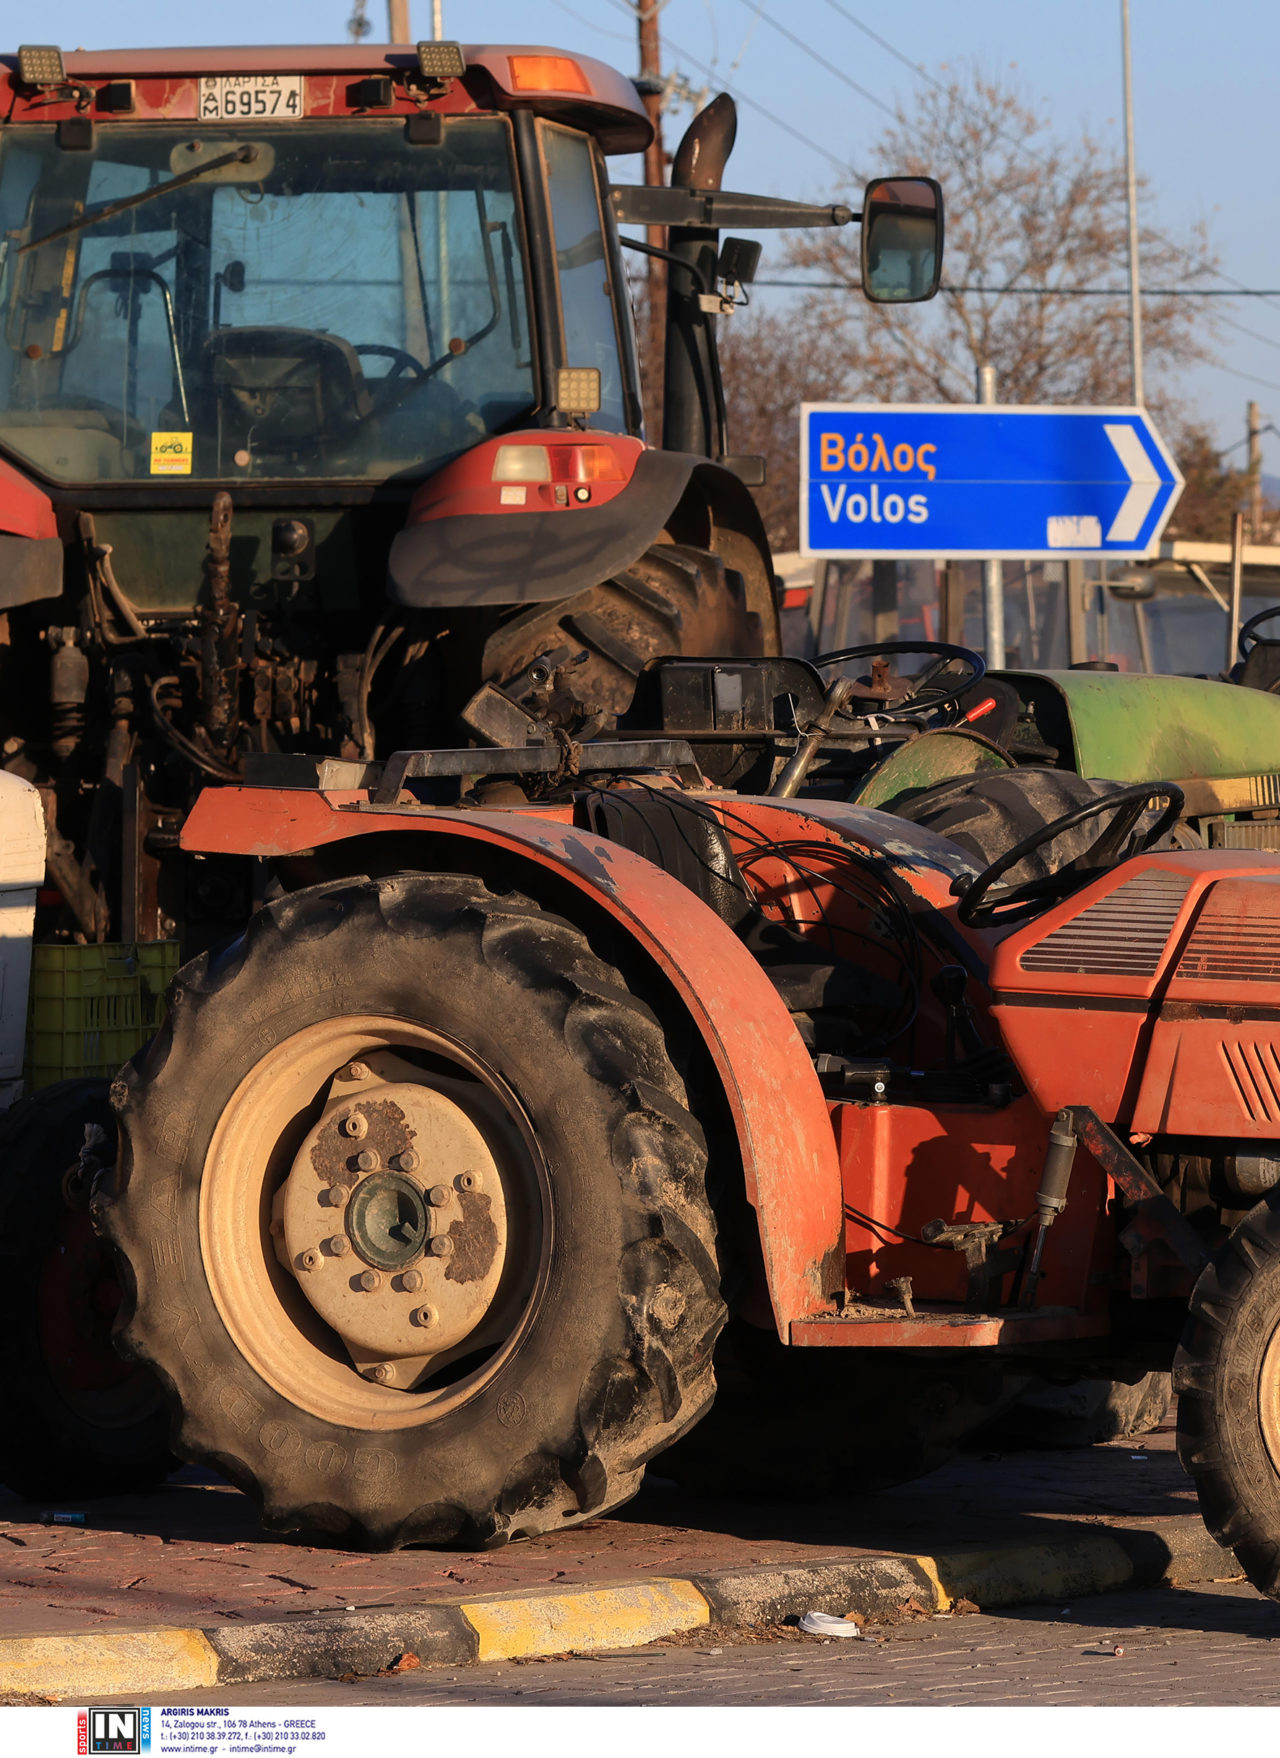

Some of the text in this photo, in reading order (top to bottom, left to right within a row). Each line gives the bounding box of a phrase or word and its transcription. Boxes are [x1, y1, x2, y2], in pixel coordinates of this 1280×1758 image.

[224, 90, 298, 115] 69574
[820, 432, 937, 481] Βόλος
[820, 483, 929, 524] Volos
